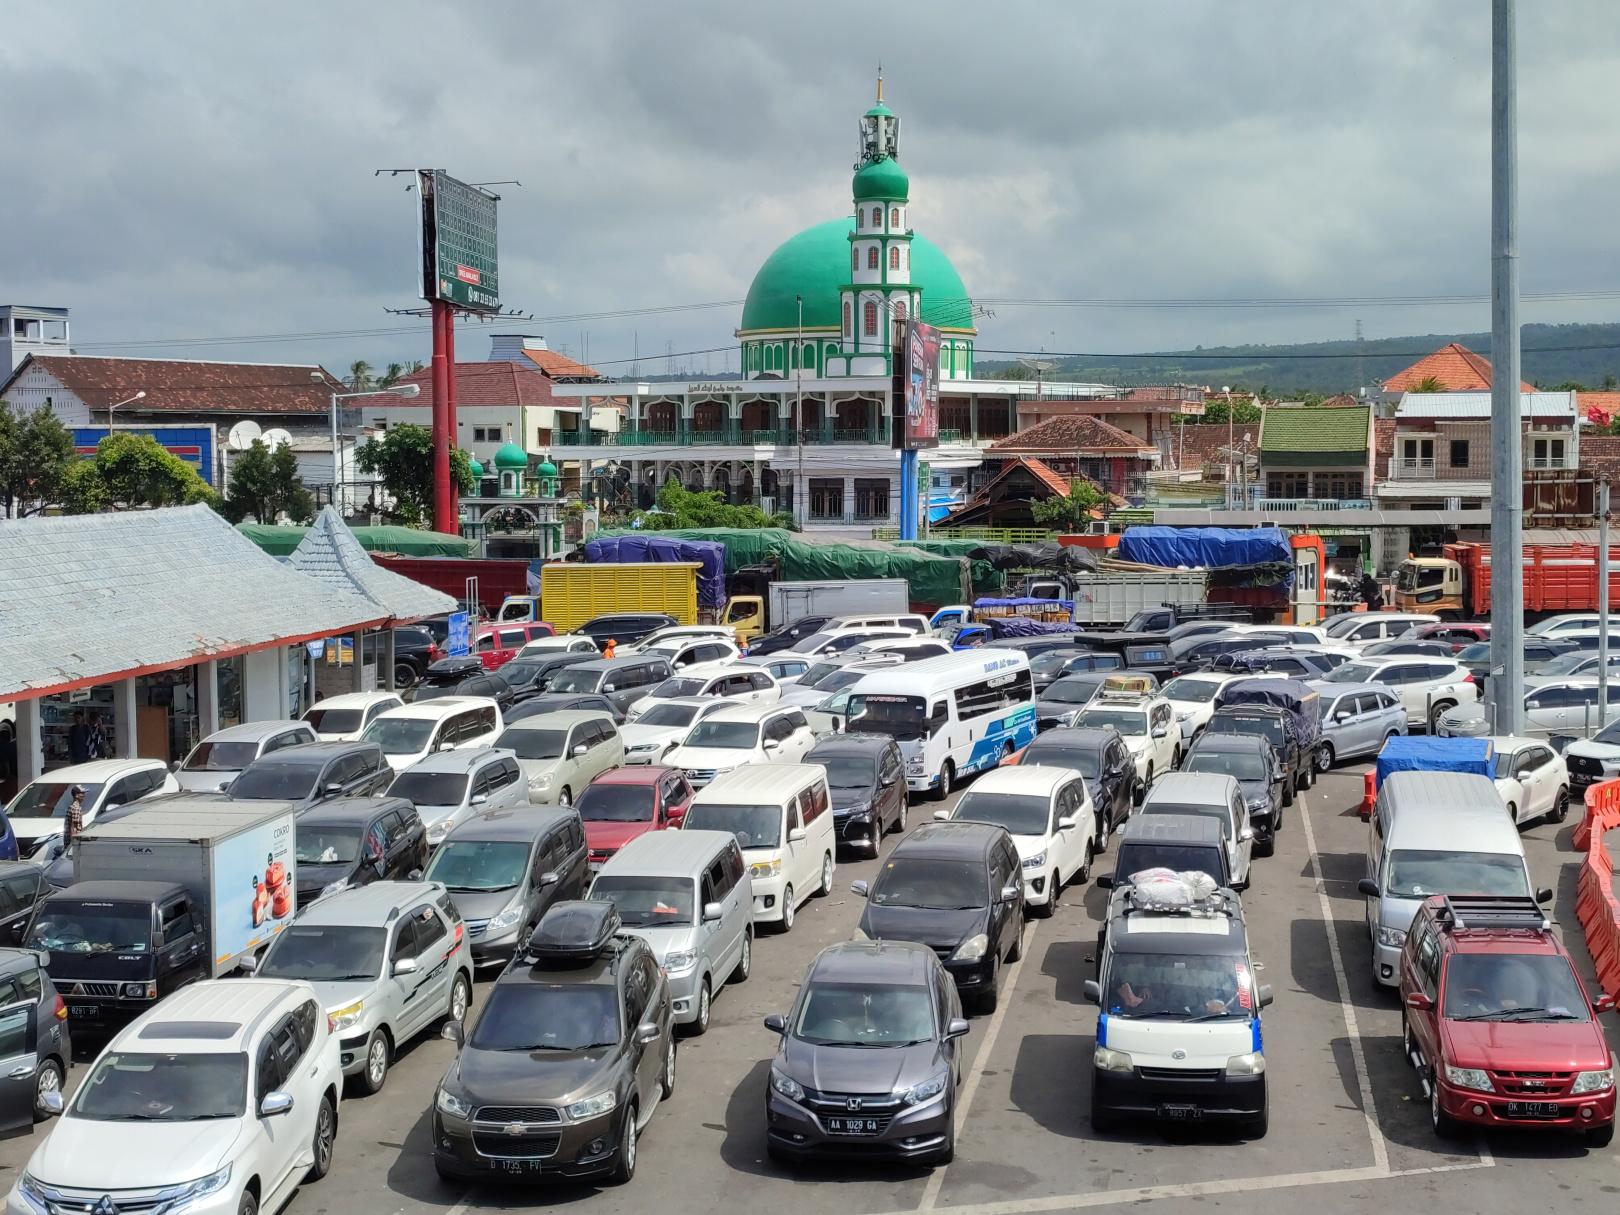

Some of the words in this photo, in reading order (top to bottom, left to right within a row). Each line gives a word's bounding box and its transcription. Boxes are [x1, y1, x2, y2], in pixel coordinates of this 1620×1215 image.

[1508, 1103, 1518, 1112] DK
[1525, 1103, 1542, 1112] 1477
[831, 1119, 841, 1129] AA
[846, 1120, 863, 1130] 1029
[867, 1120, 877, 1130] GA
